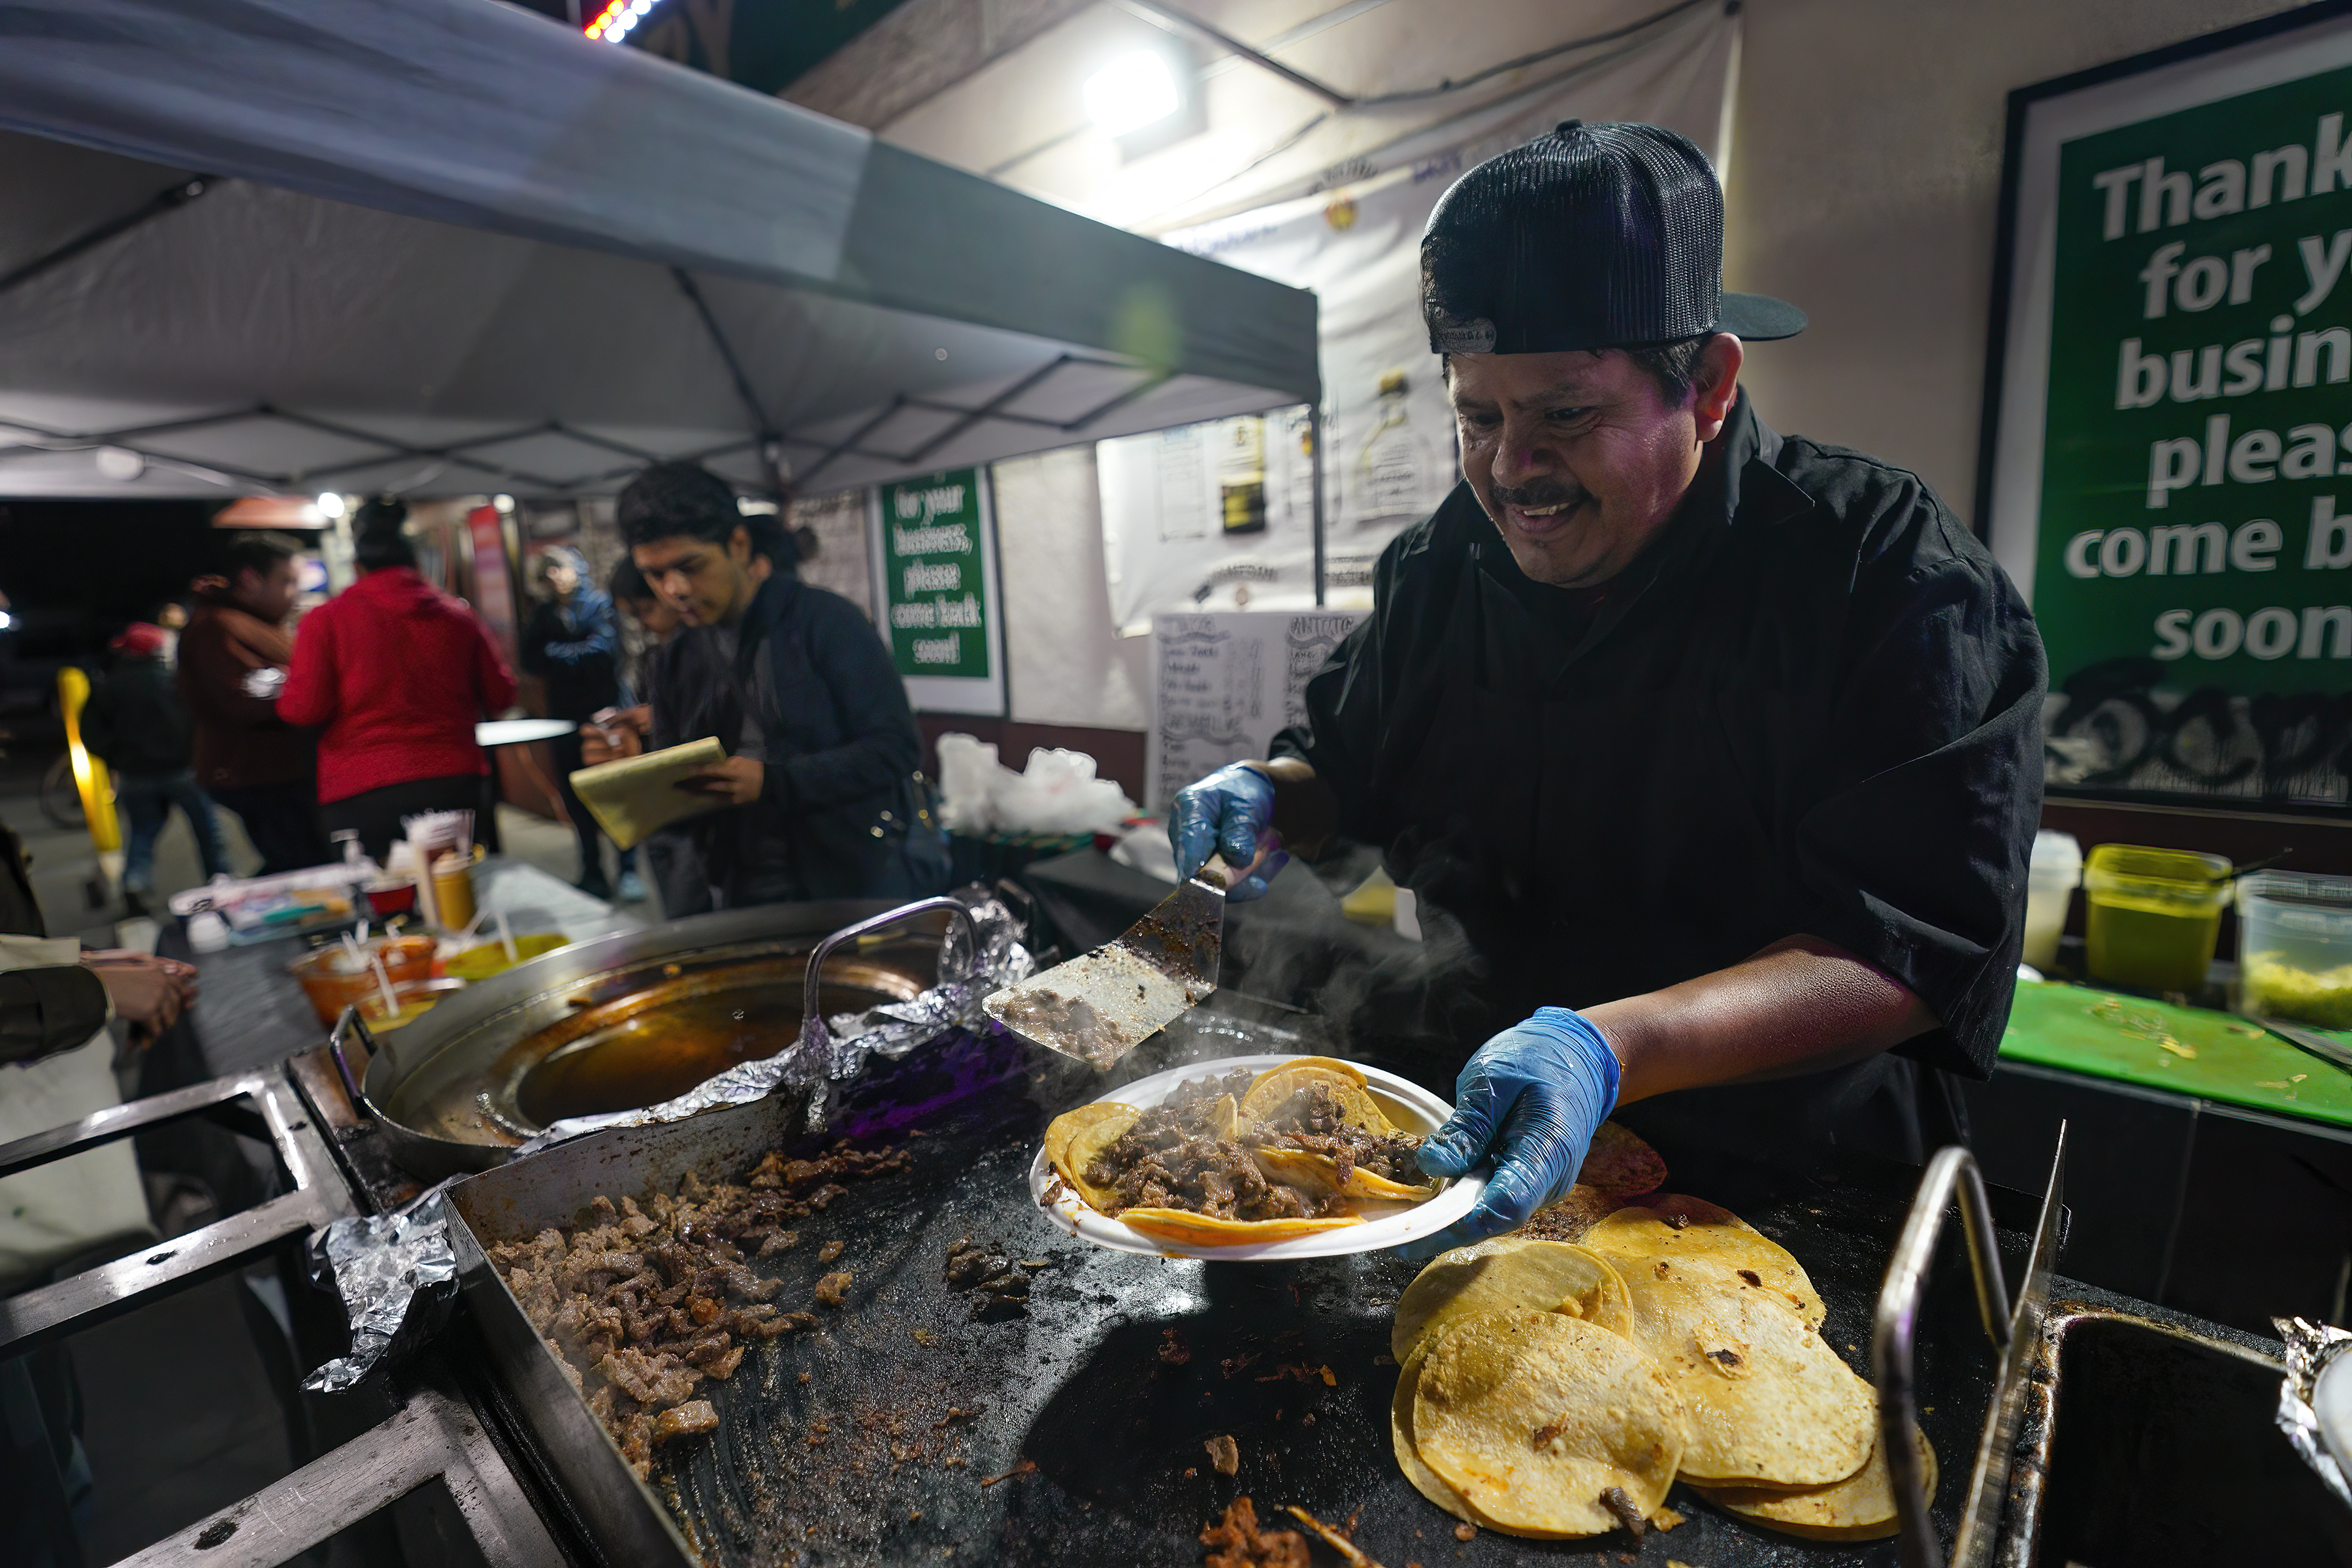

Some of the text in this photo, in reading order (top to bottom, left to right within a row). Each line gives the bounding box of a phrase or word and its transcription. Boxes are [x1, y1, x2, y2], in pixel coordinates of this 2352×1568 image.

[2138, 240, 2272, 319] for
[2114, 314, 2351, 410] busin
[2063, 519, 2284, 578] come
